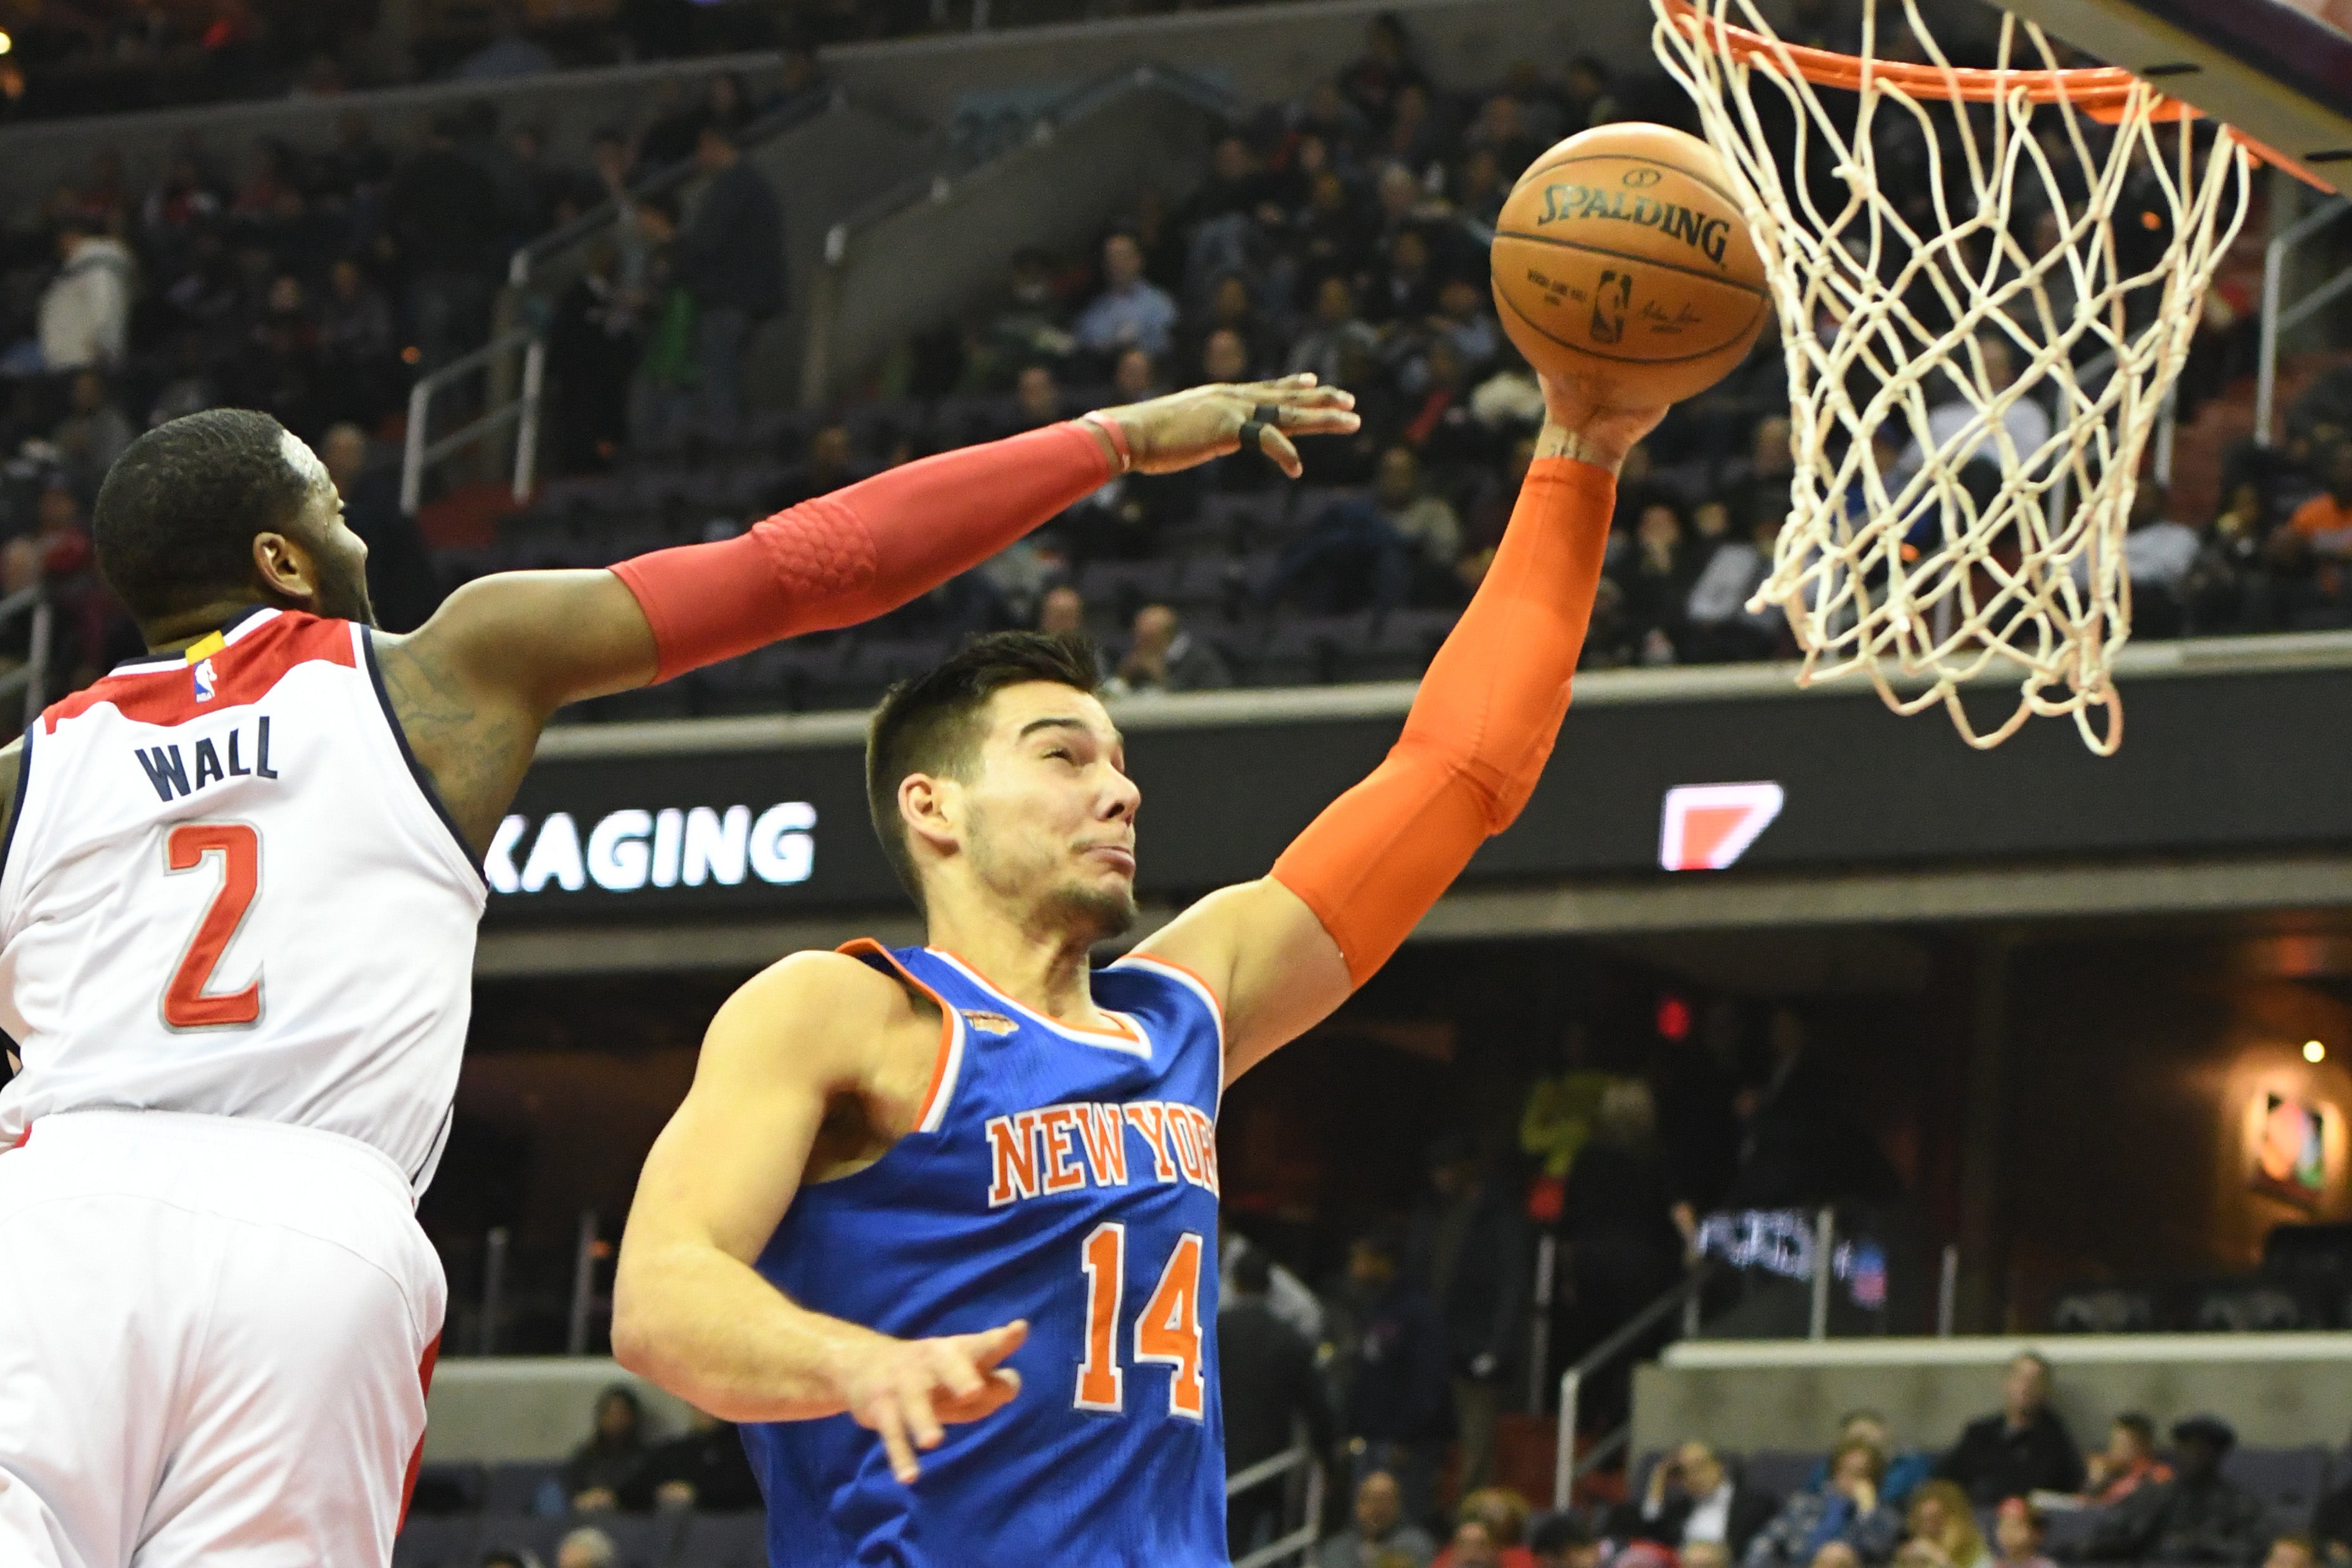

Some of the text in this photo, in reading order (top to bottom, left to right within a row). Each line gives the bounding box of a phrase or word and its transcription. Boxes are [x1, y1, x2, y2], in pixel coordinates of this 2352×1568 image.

[1537, 184, 1730, 264] SPALDING
[134, 715, 278, 802] WALL
[158, 819, 266, 1035] 2
[985, 1102, 1128, 1208] NEW
[1073, 1221, 1205, 1421] 14
